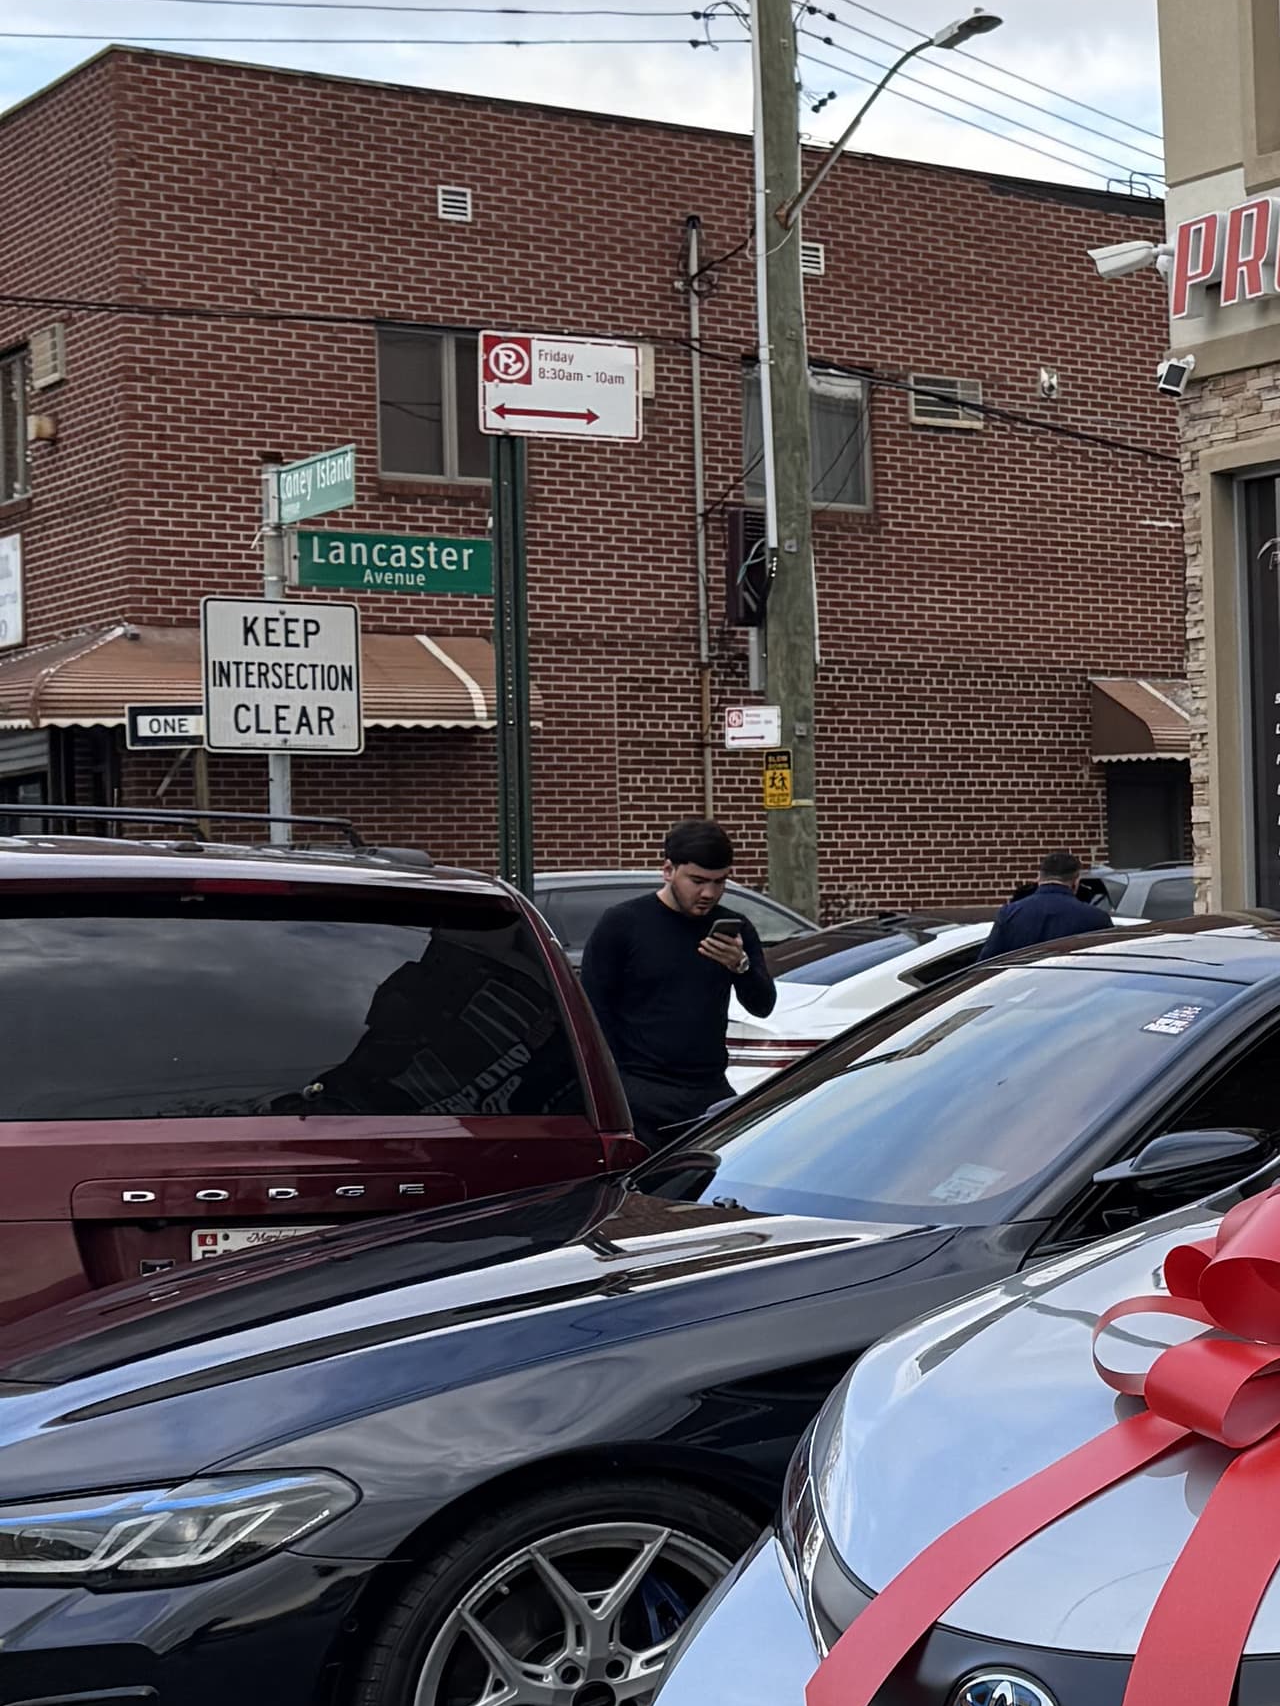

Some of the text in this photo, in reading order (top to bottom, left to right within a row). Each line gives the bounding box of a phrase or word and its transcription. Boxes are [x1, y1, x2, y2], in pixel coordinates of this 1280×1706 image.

[537, 348, 575, 366] Friday
[538, 367, 584, 383] 8:30am
[594, 371, 626, 385] 10am
[316, 451, 352, 489] Island
[312, 536, 475, 572] Lancaster
[363, 569, 426, 587] Avenue
[242, 615, 321, 649] KEEP
[212, 660, 354, 692] INTERSECTION
[148, 717, 190, 734] ONE
[233, 703, 336, 736] CLEAR
[121, 1181, 426, 1204] DODGE
